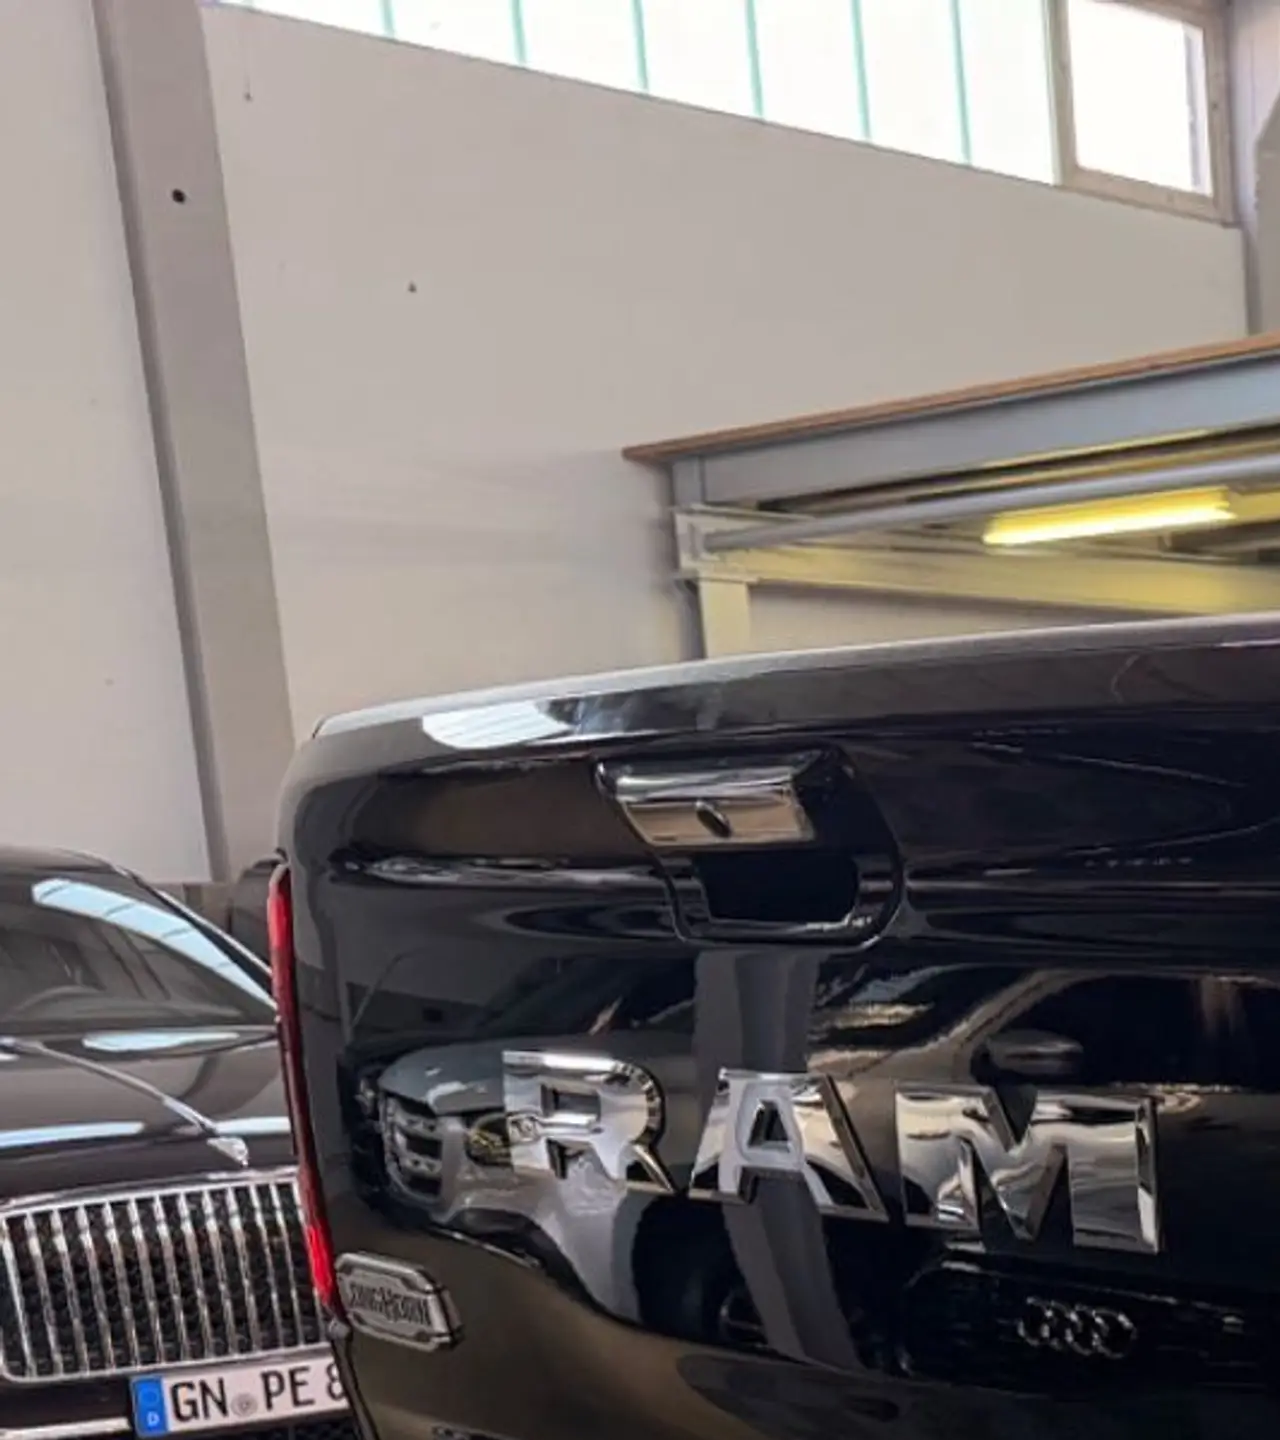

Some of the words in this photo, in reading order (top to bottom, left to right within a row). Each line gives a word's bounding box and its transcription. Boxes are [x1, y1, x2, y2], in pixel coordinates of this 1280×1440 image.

[502, 1049, 1160, 1255] RAM
[146, 1410, 161, 1427] D
[171, 1376, 229, 1422] GN
[260, 1366, 315, 1410] PE
